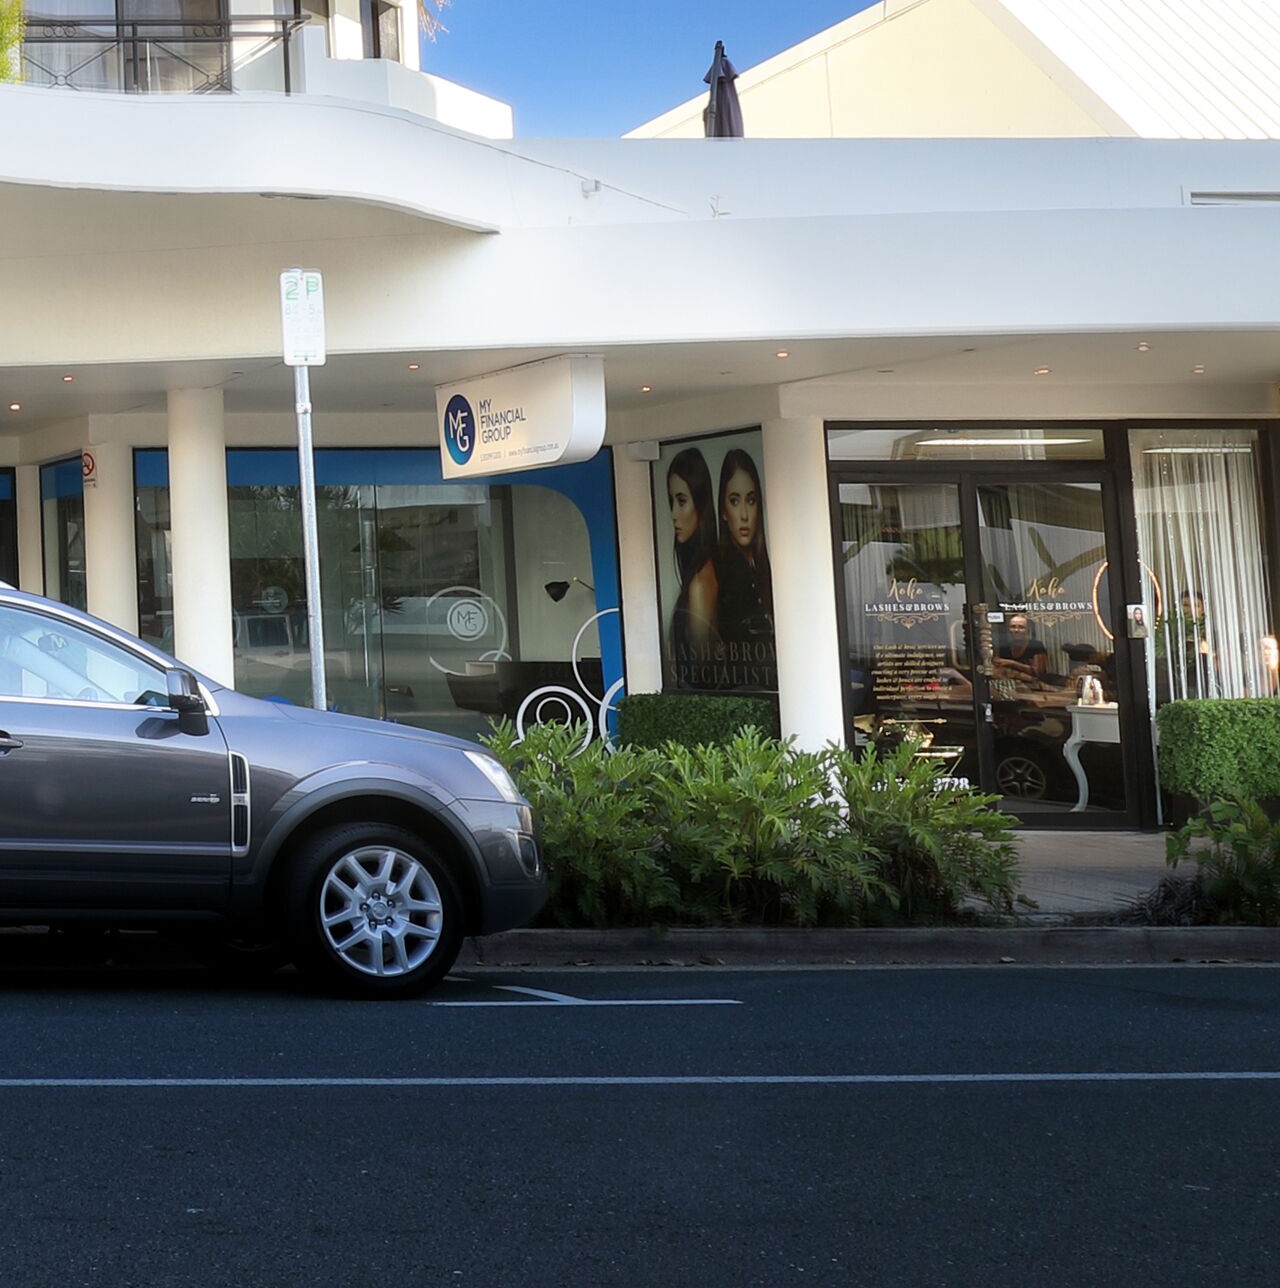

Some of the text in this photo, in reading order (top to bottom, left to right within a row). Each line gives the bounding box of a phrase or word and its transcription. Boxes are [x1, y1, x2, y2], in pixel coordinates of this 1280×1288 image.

[479, 399, 492, 414] MY
[480, 407, 526, 430] FINANCIAL
[481, 426, 512, 443] GROUP
[667, 641, 776, 662] LASH&BRO
